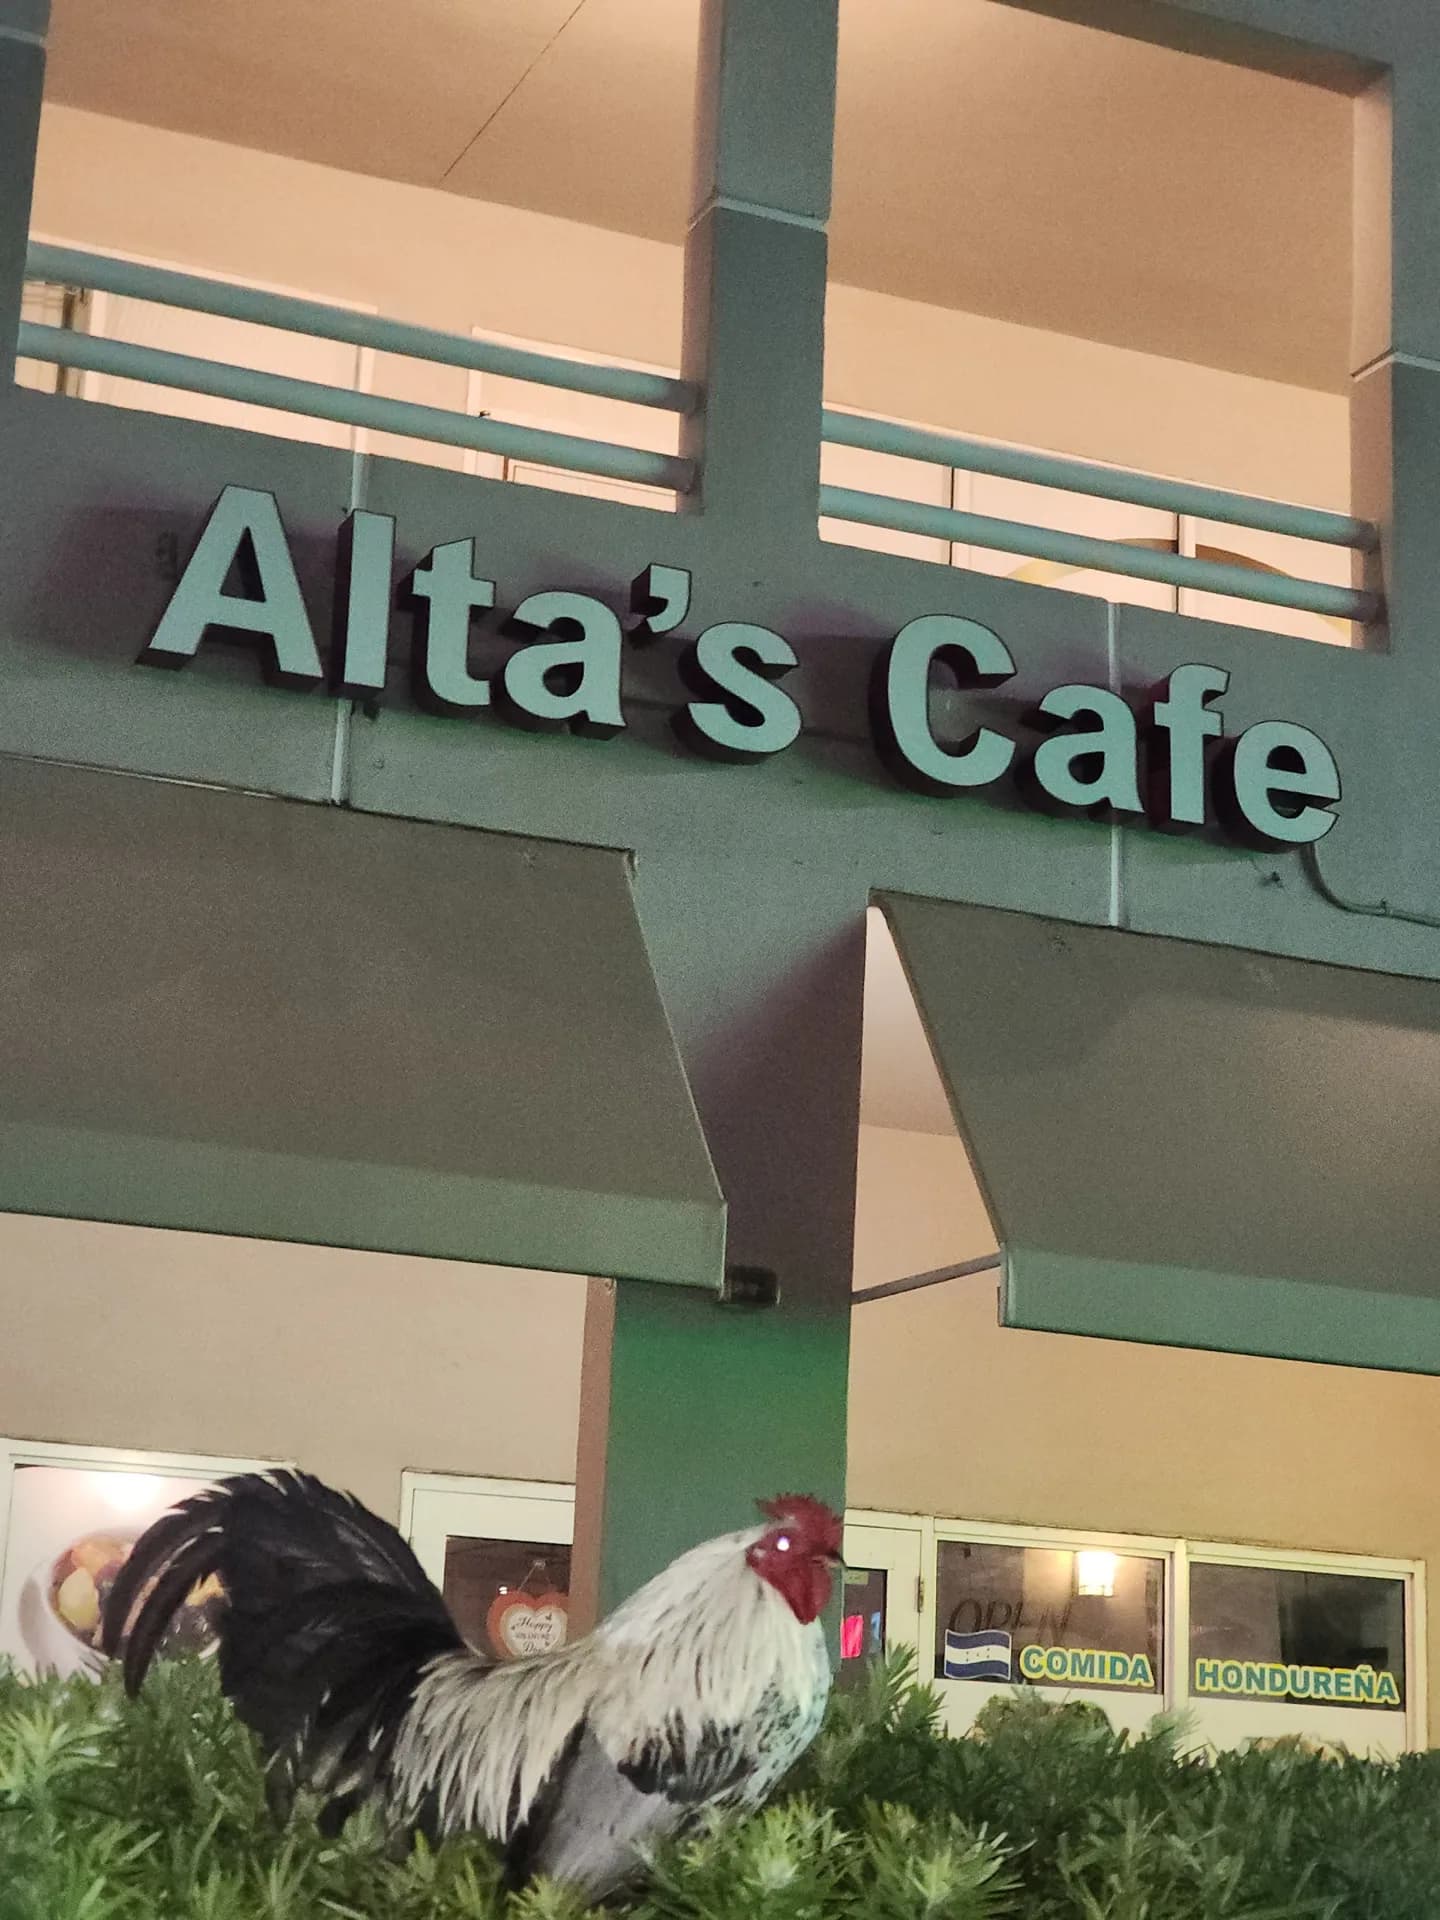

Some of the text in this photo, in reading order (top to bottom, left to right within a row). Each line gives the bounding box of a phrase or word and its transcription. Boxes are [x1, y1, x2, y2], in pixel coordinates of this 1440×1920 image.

[147, 483, 1343, 844] Alta's Cafe
[1020, 1646, 1399, 1702] COMIDA HONDUREÑA
